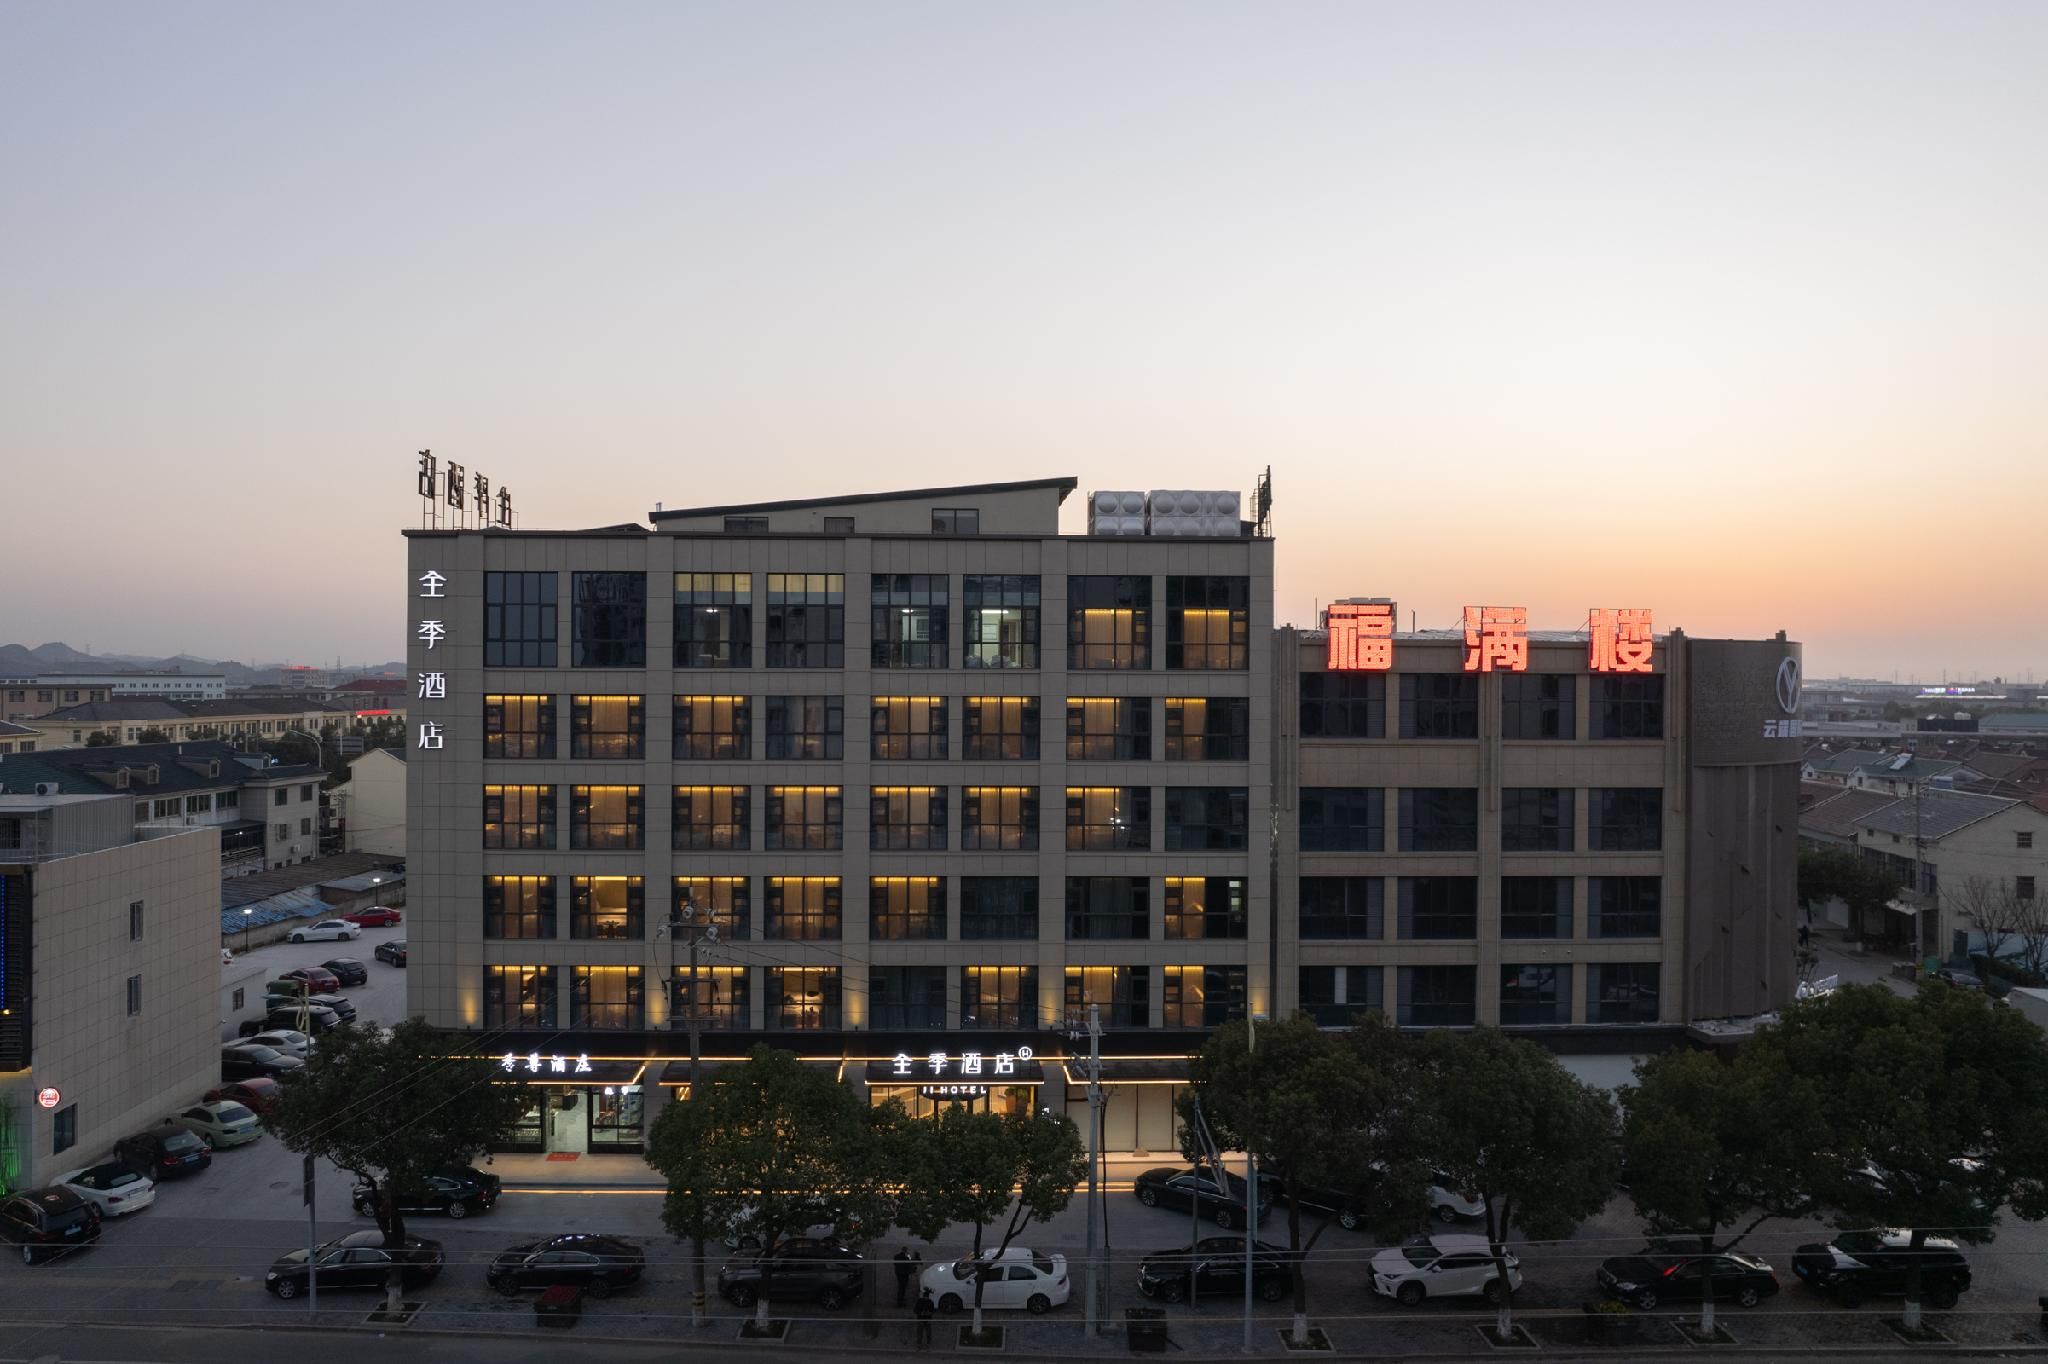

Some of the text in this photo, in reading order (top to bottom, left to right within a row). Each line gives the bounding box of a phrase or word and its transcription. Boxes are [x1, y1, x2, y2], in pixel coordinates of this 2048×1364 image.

[417, 570, 448, 749] 全季酒店
[1327, 603, 1654, 673] 福满楼
[891, 1052, 1015, 1075] 全季酒店
[940, 1086, 987, 1095] HOTEL
